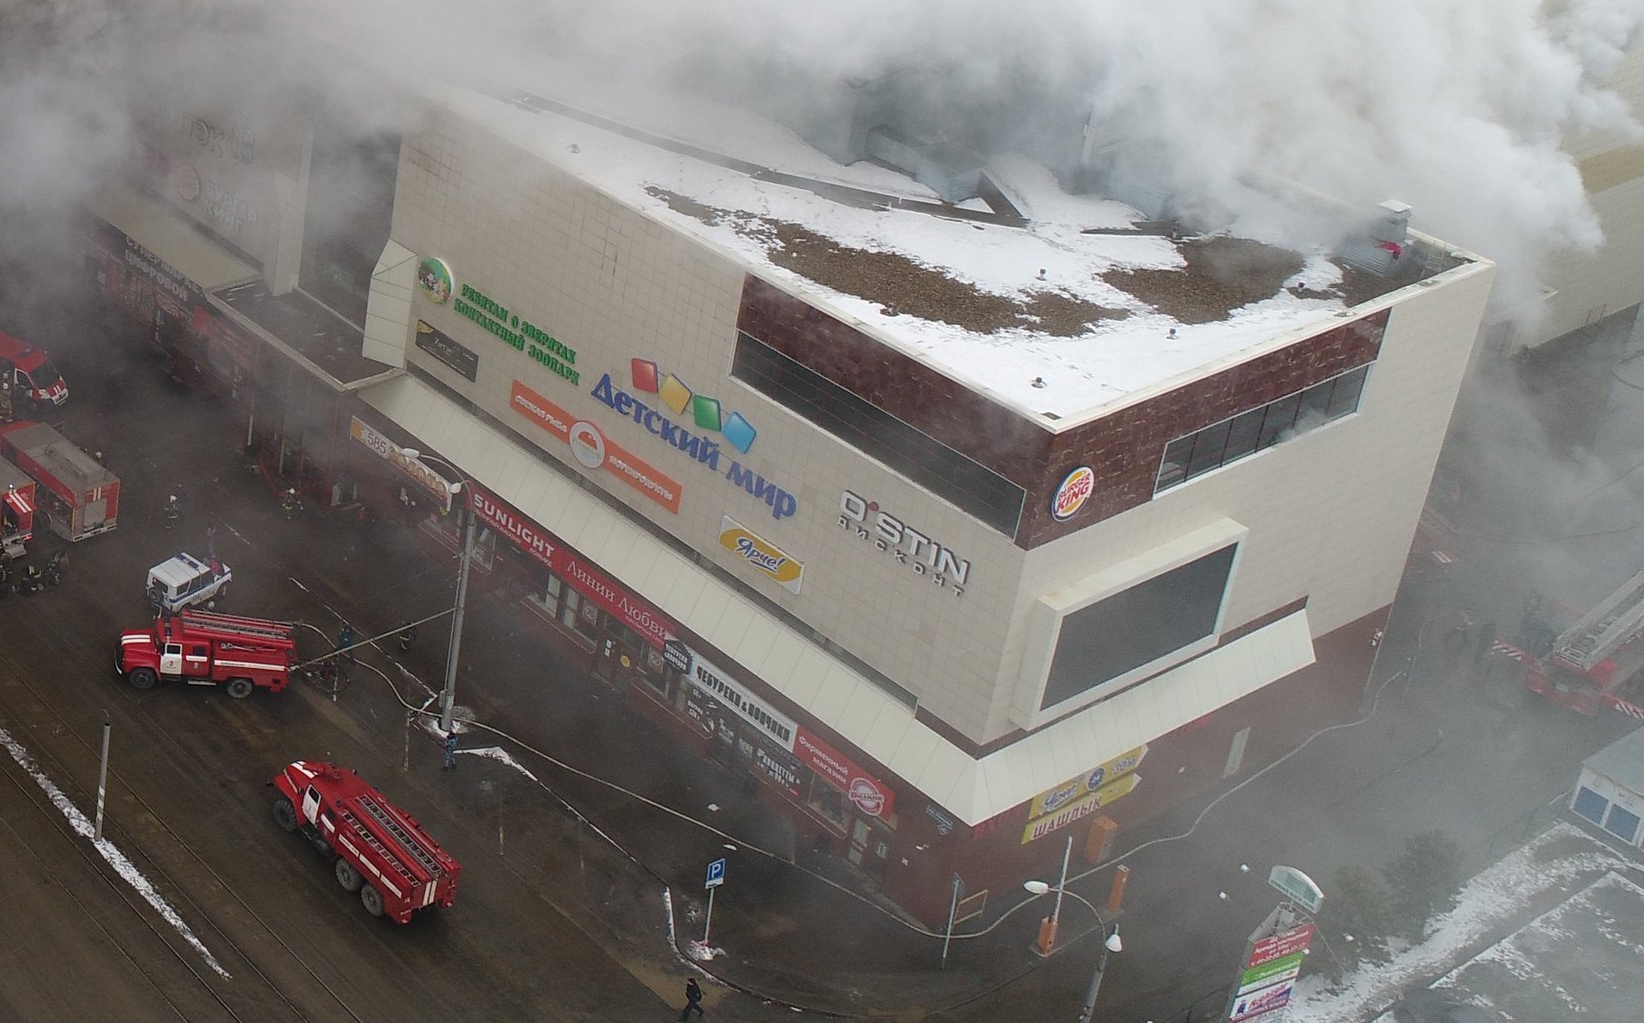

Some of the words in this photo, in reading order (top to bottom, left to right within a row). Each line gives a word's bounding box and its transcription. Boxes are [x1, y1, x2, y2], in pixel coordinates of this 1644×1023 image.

[511, 315, 519, 329] О
[528, 344, 580, 387] ЗООПАРК
[367, 431, 388, 455] 585
[590, 373, 720, 472] Детский
[726, 461, 798, 521] мир
[1057, 481, 1091, 511] KING
[1059, 475, 1091, 499] BURGER
[474, 493, 555, 558] SUNLIGHT
[736, 538, 786, 574] Ярче!
[566, 560, 616, 603] Линии
[618, 596, 669, 638] Любви
[696, 664, 742, 708] ЧЕБУРЕКИ
[747, 702, 791, 743] ПОНЧИКИ
[798, 735, 849, 775] Фирменный
[812, 756, 847, 785] магазин
[1030, 795, 1102, 841] ШАШЛЫК
[711, 862, 722, 879] P
